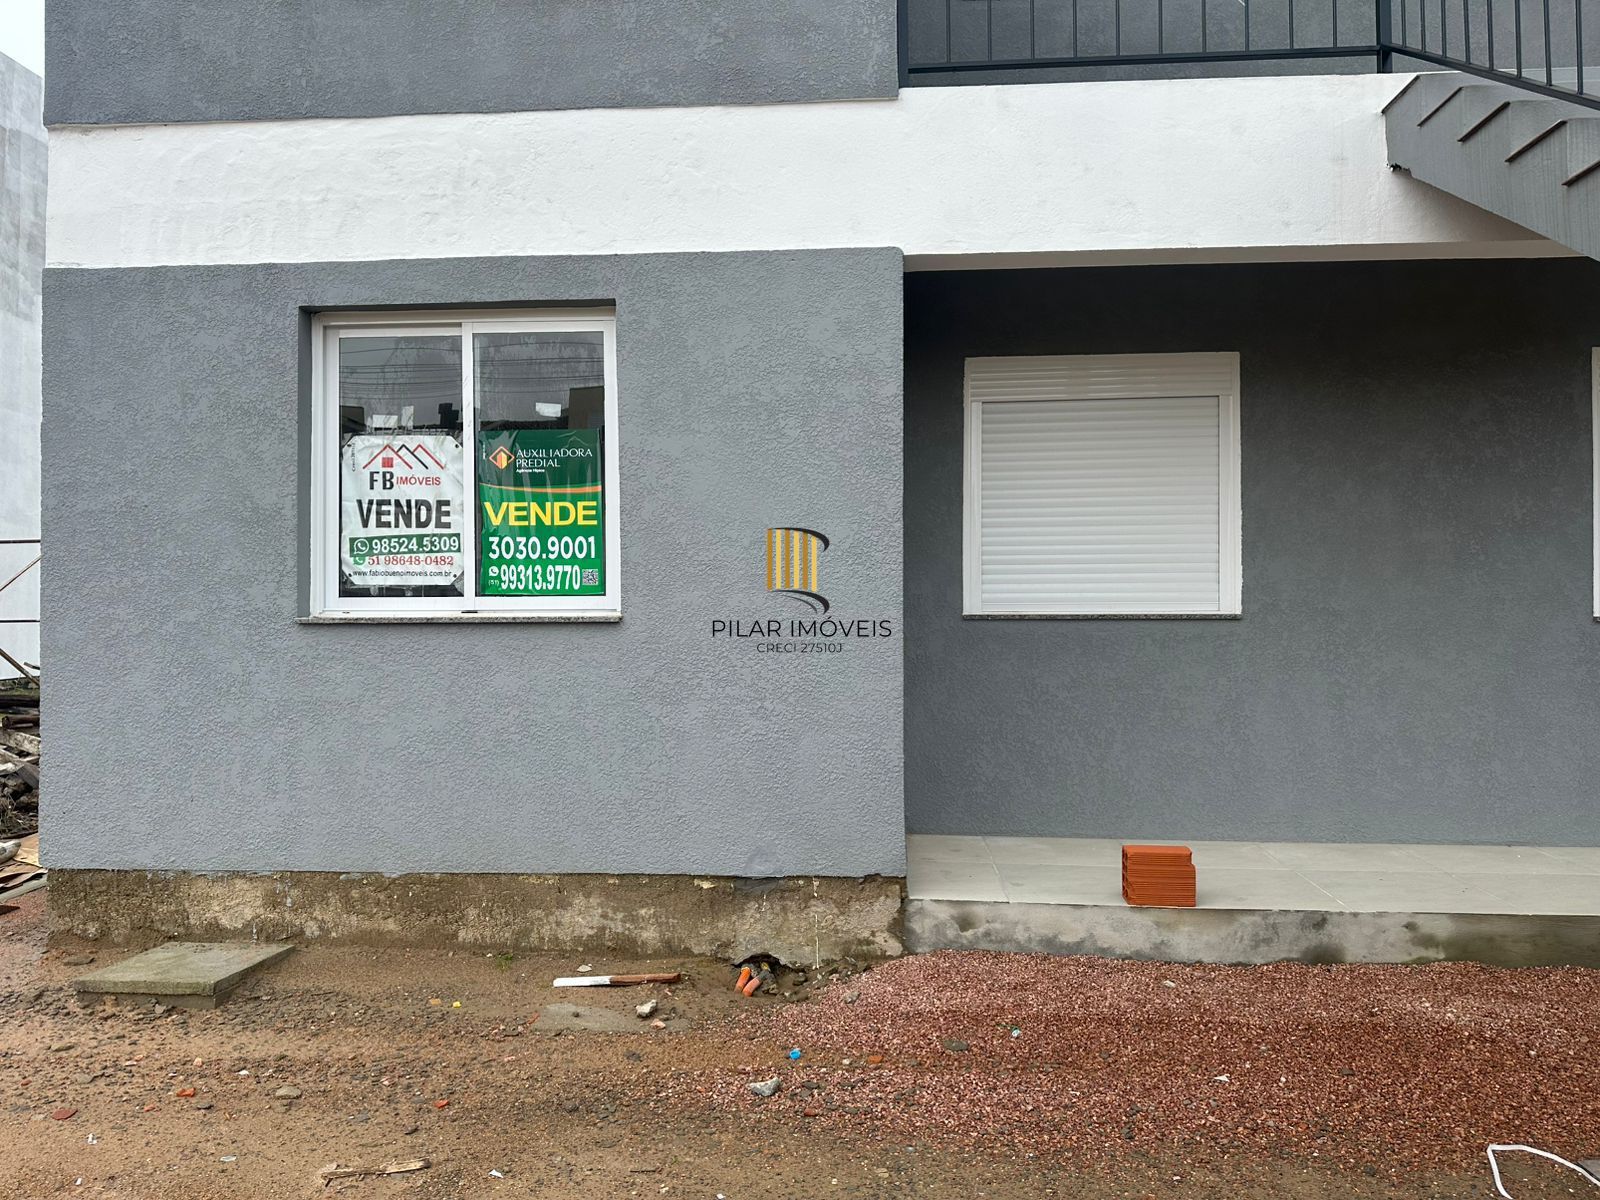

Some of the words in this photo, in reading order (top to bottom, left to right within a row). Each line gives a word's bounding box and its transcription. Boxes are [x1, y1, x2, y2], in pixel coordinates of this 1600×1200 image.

[516, 448, 593, 458] AUXILIADORA
[516, 458, 560, 468] PREDIAL
[369, 471, 394, 490] FB
[396, 474, 441, 486] IMÓVEIS
[356, 499, 451, 529] VENDE
[484, 501, 598, 526] VENDE
[372, 536, 459, 553] 98524.5309
[488, 536, 596, 560] 3030.9001
[384, 555, 454, 566] 98648-0482
[500, 564, 580, 590] 99313.9770
